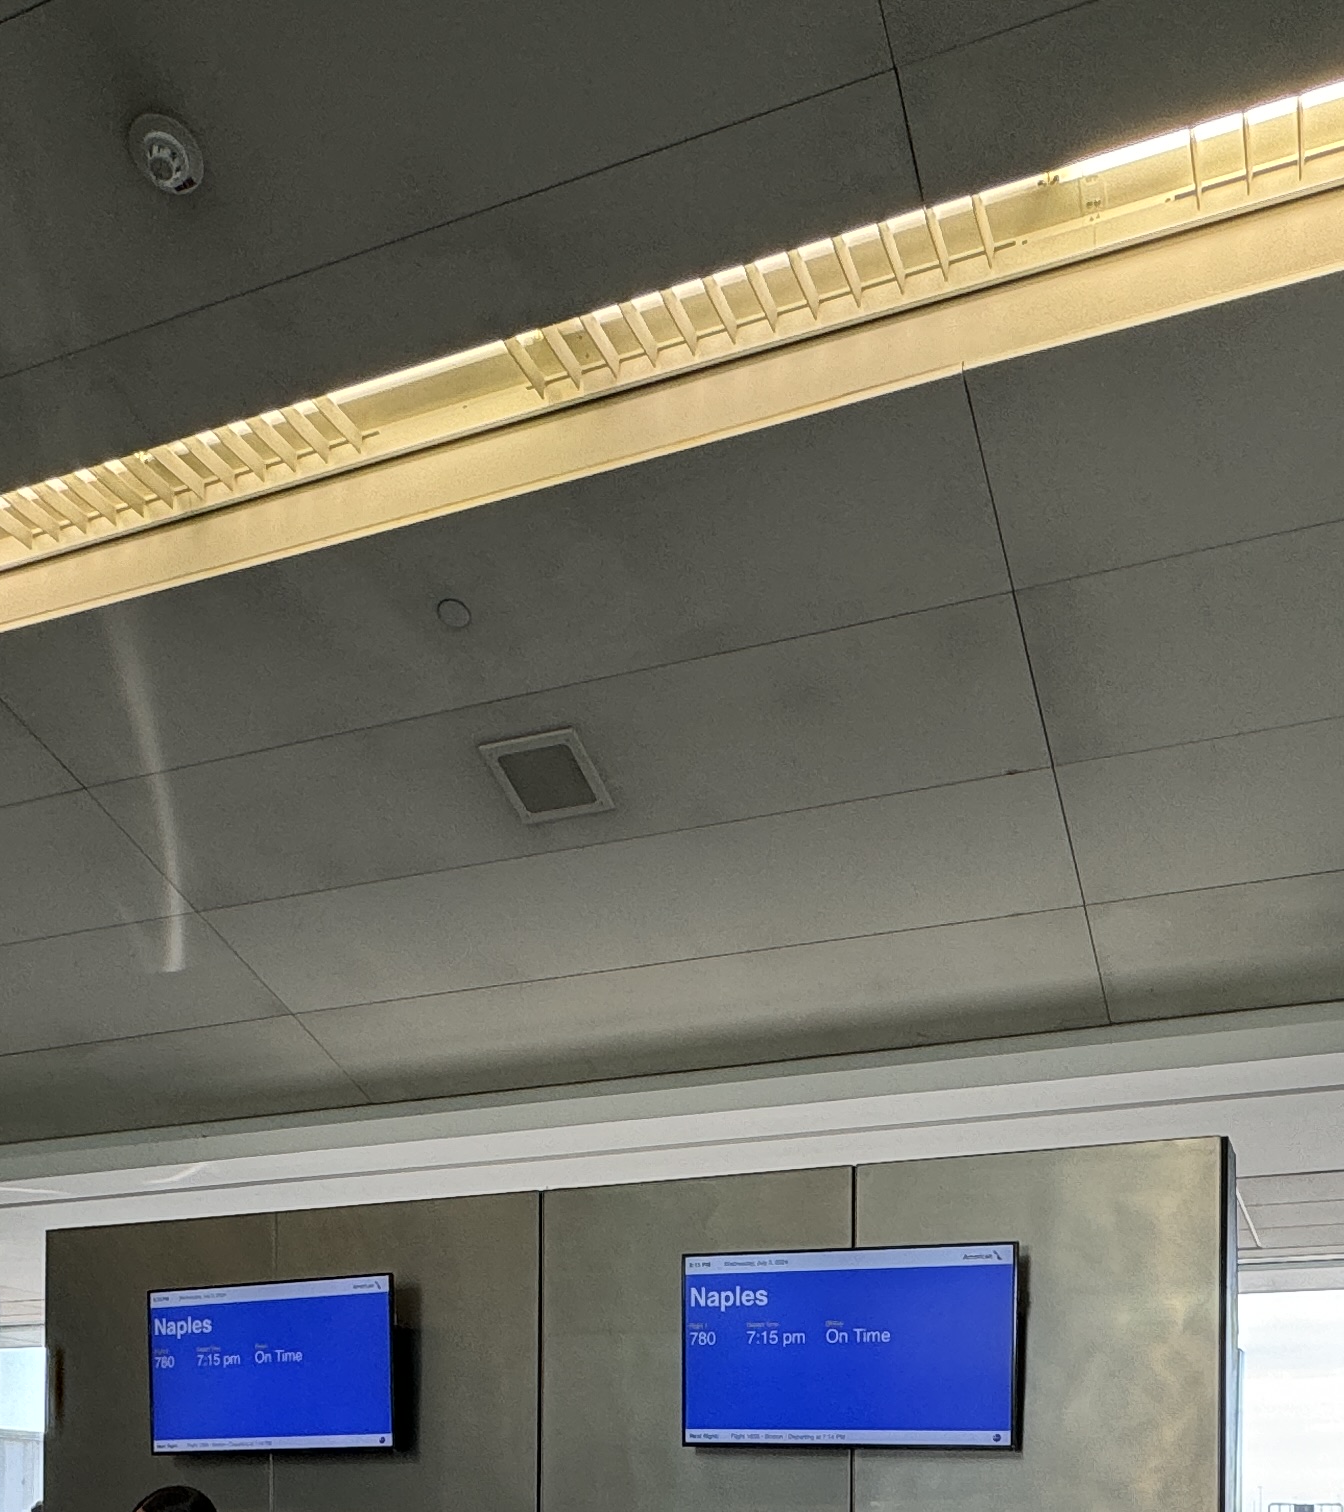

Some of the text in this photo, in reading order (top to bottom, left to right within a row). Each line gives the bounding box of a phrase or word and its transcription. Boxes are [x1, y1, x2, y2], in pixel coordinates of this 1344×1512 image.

[690, 1285, 768, 1312] Naples
[154, 1316, 212, 1339] Naples
[825, 1328, 891, 1344] On Time
[689, 1330, 806, 1348] 780 7:15 pm
[156, 1353, 240, 1368] 780 7:15 pm
[255, 1349, 303, 1364] On Time
